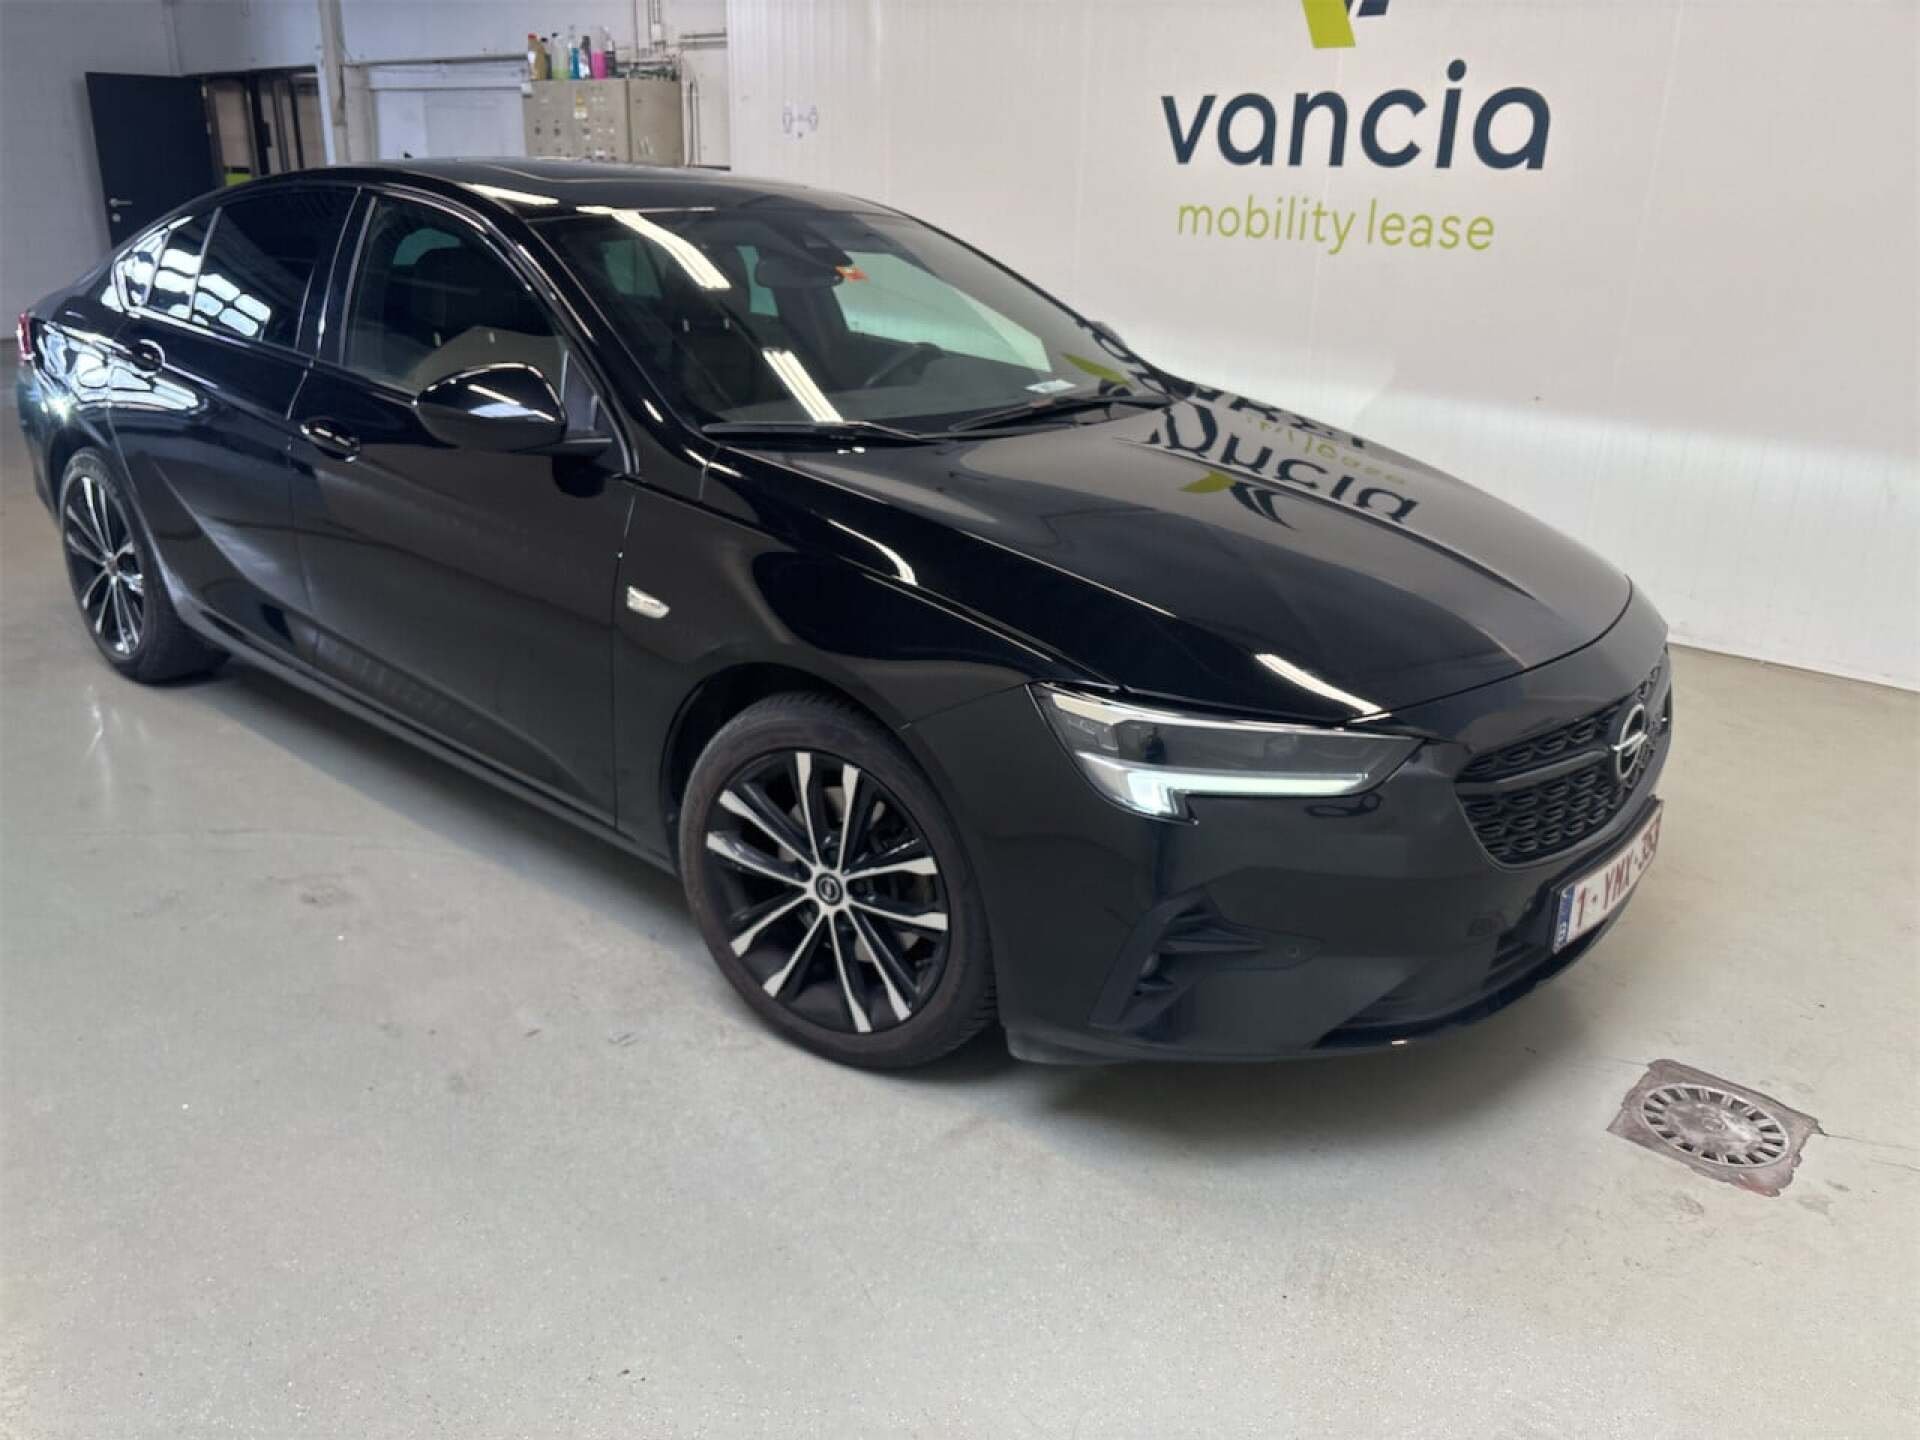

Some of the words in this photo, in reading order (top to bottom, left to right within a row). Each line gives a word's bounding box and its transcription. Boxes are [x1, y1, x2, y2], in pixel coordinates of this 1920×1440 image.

[1161, 59, 1551, 170] vancia
[1177, 195, 1356, 255] mobility
[1367, 198, 1494, 250] lease
